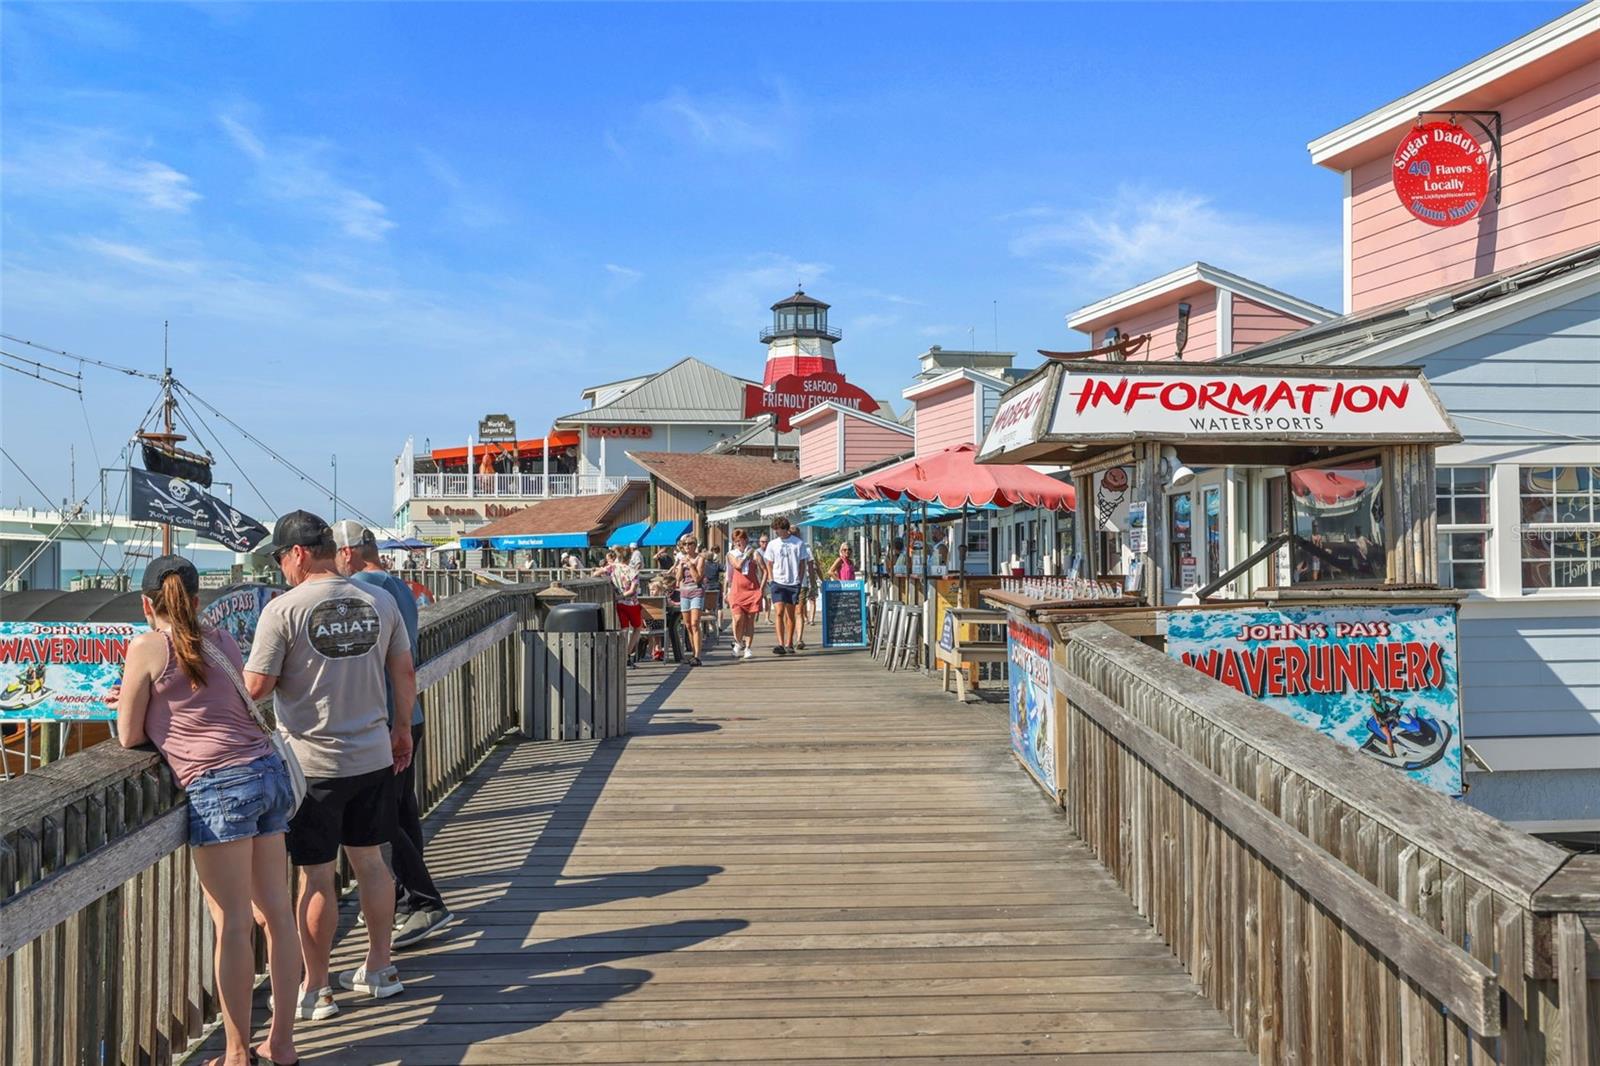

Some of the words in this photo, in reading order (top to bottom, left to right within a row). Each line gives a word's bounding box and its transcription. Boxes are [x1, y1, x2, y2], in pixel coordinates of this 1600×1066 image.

[1394, 133, 1429, 170] Sugar
[1433, 129, 1485, 165] Daddy's
[1408, 160, 1431, 176] 40
[1435, 165, 1473, 175] Flavors
[1424, 179, 1465, 191] Locally
[803, 380, 838, 394] SEAFOOD
[762, 392, 807, 409] FRIENDLY
[1069, 377, 1409, 416] INFORMATION
[588, 426, 653, 438] HOOTERS
[1189, 416, 1324, 432] WATERSPORTS
[427, 505, 440, 516] Ice
[444, 505, 476, 516] Cream
[176, 516, 210, 528] Conquest
[201, 599, 231, 626] OHN'S
[232, 592, 254, 612] PASS
[32, 625, 91, 635] JOHN'S
[96, 625, 134, 635] PASS
[315, 620, 376, 638] ARIAT
[1237, 622, 1329, 641] JOHN'S
[1336, 620, 1392, 638] PASS
[0, 637, 129, 664] WAVERUNN
